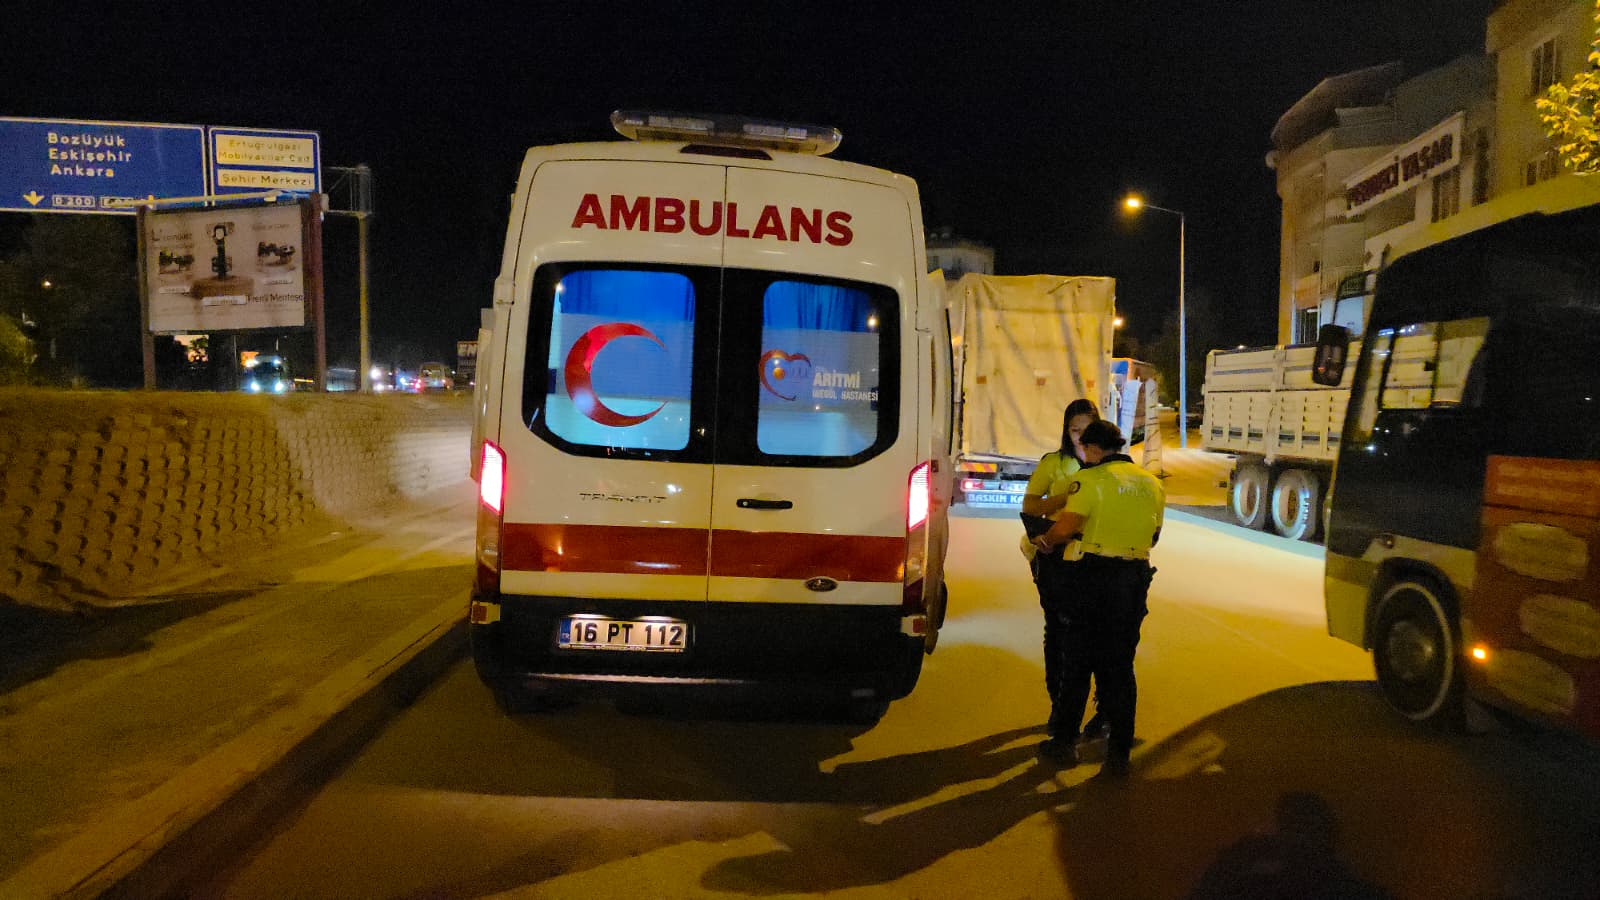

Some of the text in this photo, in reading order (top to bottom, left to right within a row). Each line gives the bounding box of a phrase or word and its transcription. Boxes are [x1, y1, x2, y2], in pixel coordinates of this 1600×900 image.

[47, 132, 125, 148] Bozüyük
[48, 148, 132, 162] Eskişehir
[50, 164, 114, 178] Ankara
[261, 175, 311, 186] Merkezi
[571, 193, 853, 247] AMBULANS
[813, 369, 861, 388] ARİTMİ
[841, 389, 879, 402] HASTANESİ
[574, 622, 684, 646] 16 PT 112
